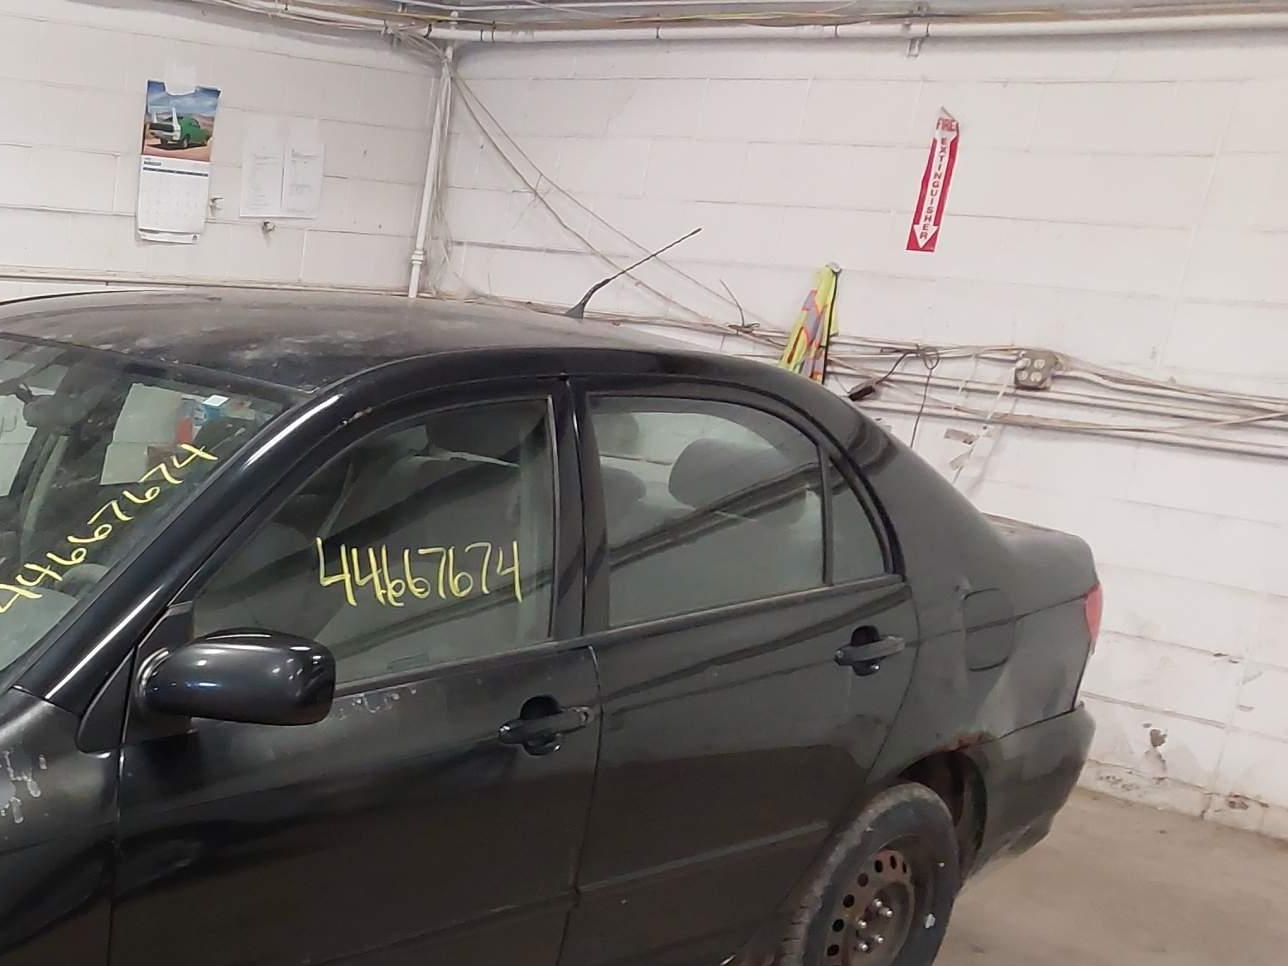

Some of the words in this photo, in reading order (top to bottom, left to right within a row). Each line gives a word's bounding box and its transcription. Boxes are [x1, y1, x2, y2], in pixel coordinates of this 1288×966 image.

[936, 117, 956, 132] FIRE
[919, 138, 947, 240] EXTINGUISHER
[316, 536, 523, 607] 44667674
